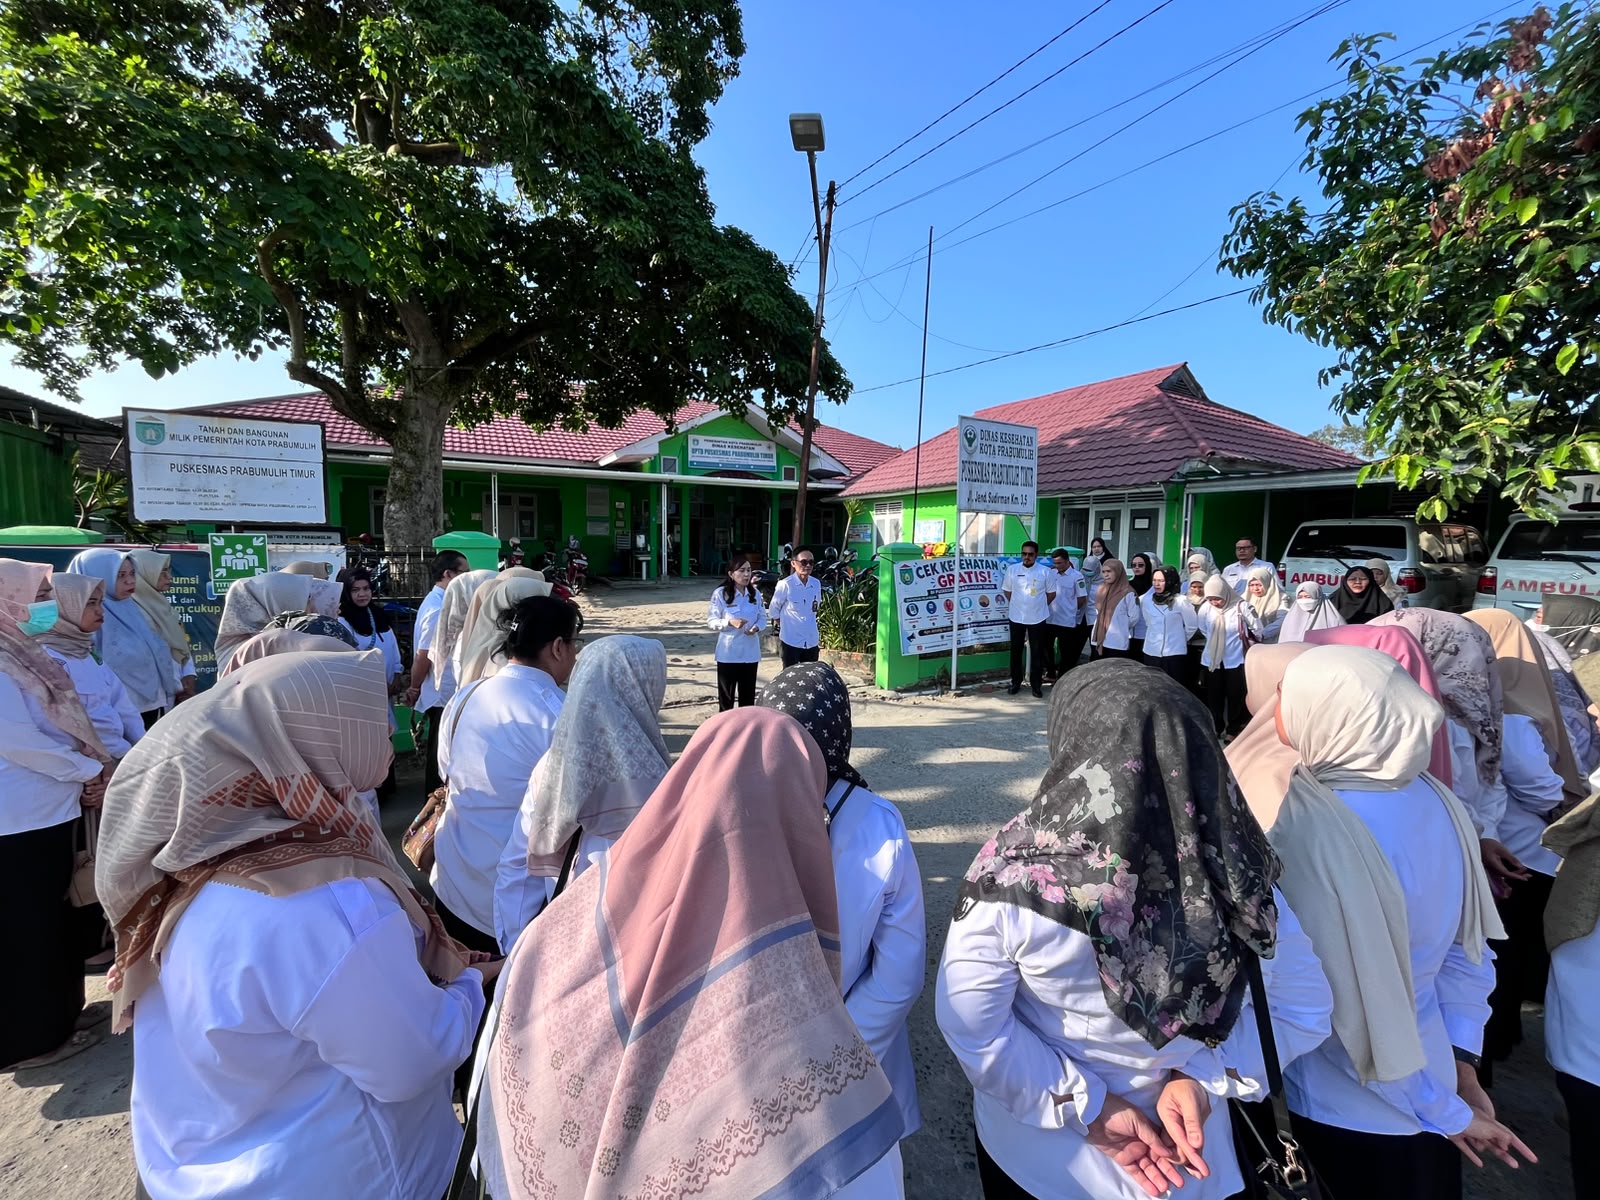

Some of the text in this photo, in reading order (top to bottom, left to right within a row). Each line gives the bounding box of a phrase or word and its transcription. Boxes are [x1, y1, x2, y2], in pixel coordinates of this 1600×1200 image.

[198, 425, 289, 439] TANAH DAN BANGUNAN
[980, 429, 1034, 447] DINAS KESEHATAN
[169, 433, 317, 450] MILIK PEMERINTAH KOTA PRABUMULIH
[979, 442, 1034, 460] KOTA PRABUMULIH
[169, 463, 316, 479] PUSKESMAS PRABUMULIH TIMUR
[961, 460, 1034, 488] PUSKESMAS PRABUMULIH TIMUR
[988, 492, 1010, 504] Sudirman
[916, 562, 940, 578] CEK
[172, 575, 198, 584] umsi
[937, 571, 992, 588] GRATIS!
[1500, 579, 1600, 596] AMBUL
[166, 594, 177, 604] at
[188, 604, 220, 614] cukup
